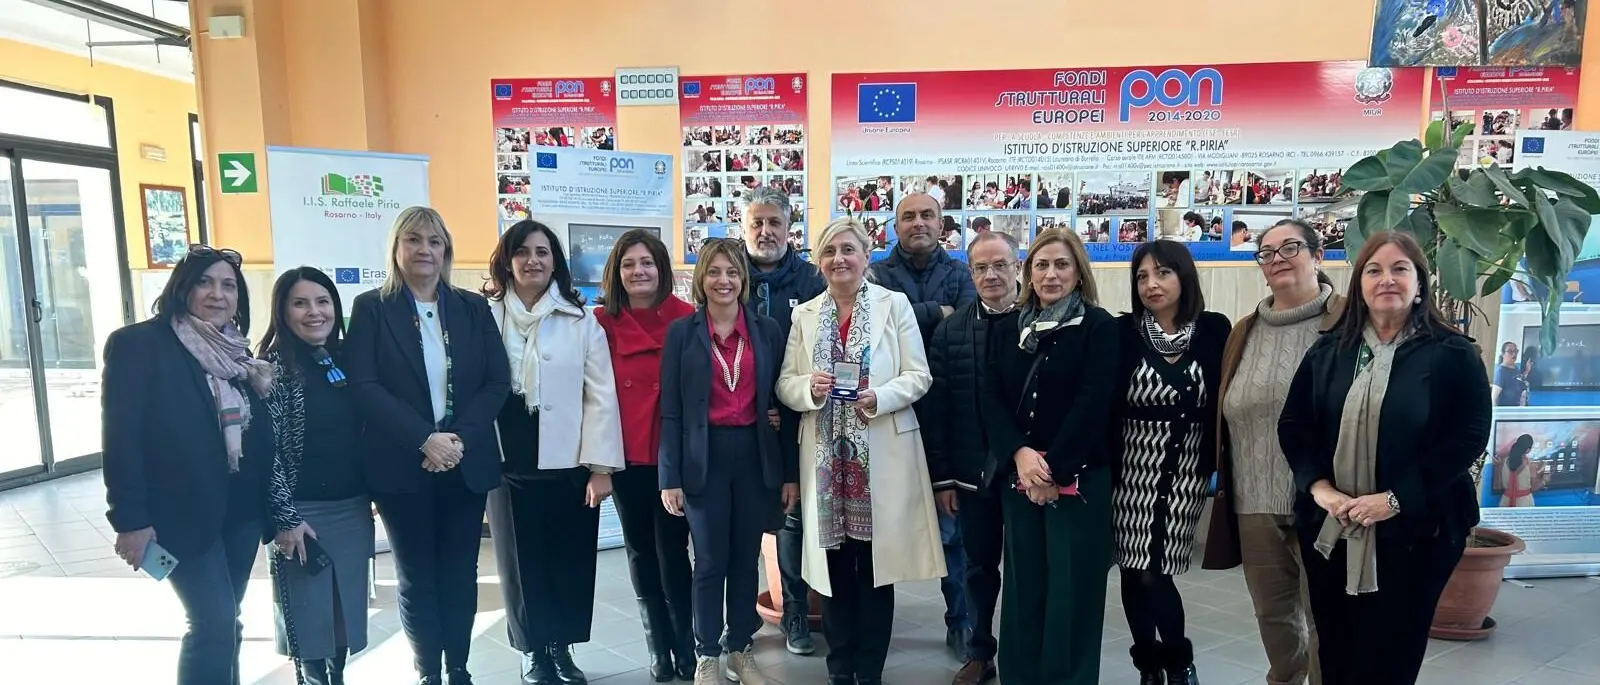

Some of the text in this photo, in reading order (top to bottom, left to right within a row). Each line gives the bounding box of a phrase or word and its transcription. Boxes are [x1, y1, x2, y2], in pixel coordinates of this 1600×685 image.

[1055, 71, 1106, 86] FONDI
[995, 90, 1105, 107] STRUTTURALI
[1120, 68, 1224, 122] pon
[1033, 110, 1104, 124] EUROPEI
[1148, 110, 1221, 122] 2014-2020
[1363, 108, 1382, 116] MIUR
[1004, 142, 1048, 154] ISTITUTO
[1052, 141, 1124, 154] D'ISTRUZIONE
[1126, 140, 1182, 152] SUPERIORE
[610, 157, 634, 172] pon
[303, 196, 400, 209] I.I.S. Raffaele Piria
[324, 210, 356, 219] Rosarno
[365, 212, 382, 220] Italy
[362, 268, 387, 279] Eras
